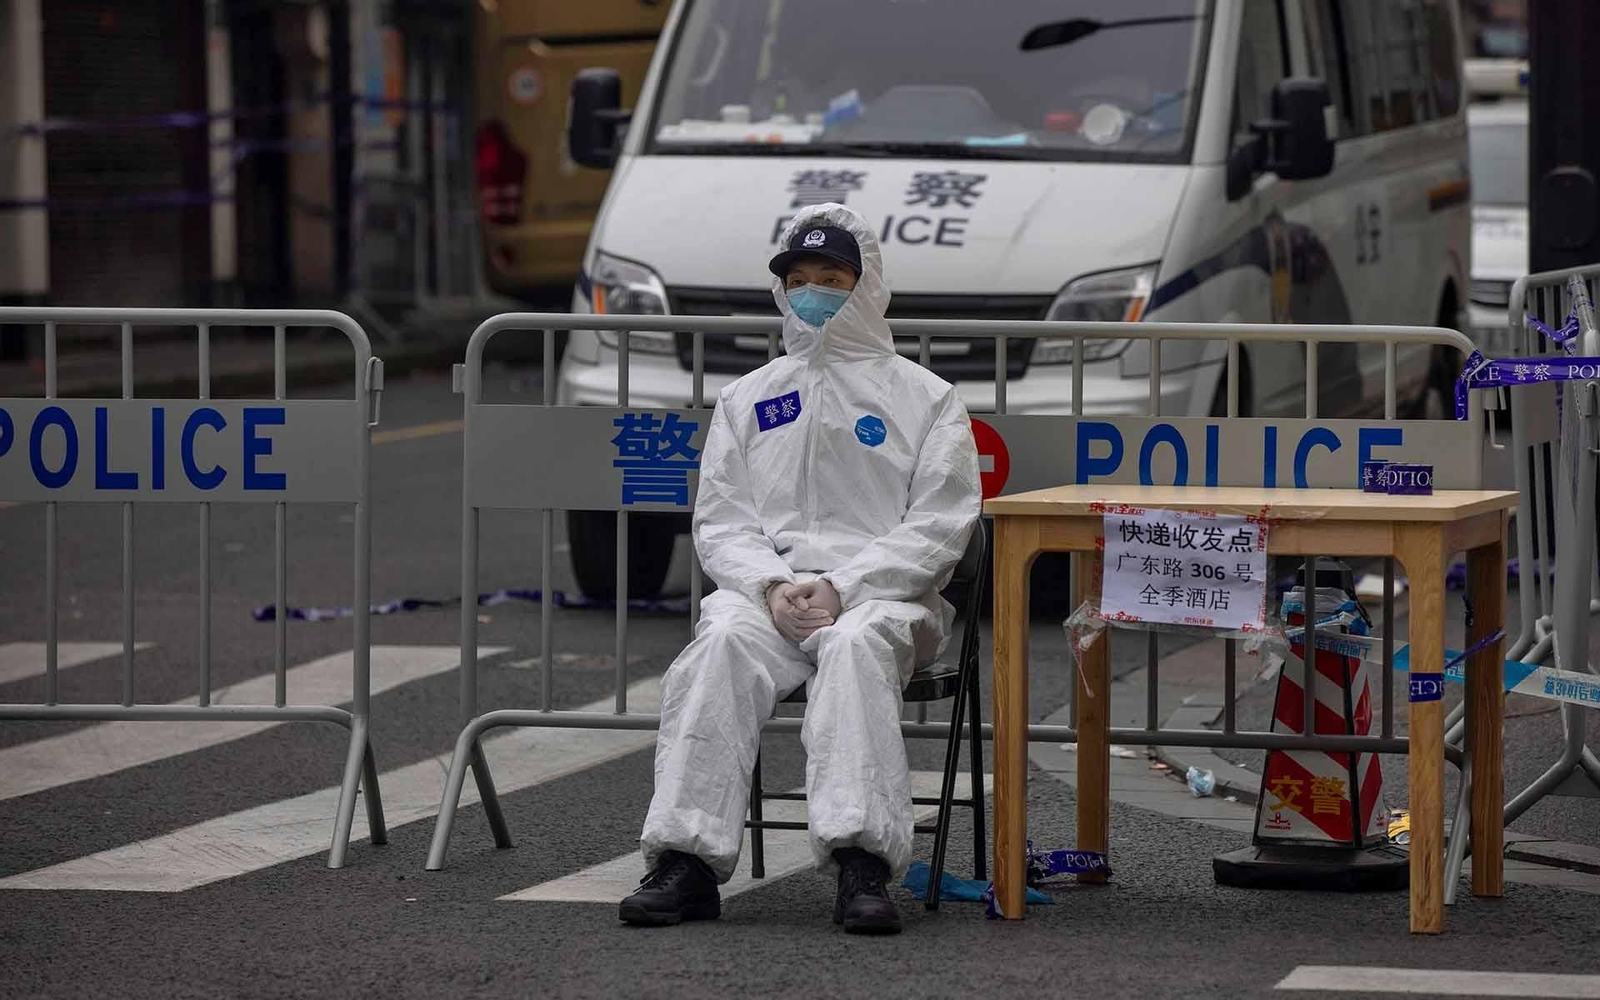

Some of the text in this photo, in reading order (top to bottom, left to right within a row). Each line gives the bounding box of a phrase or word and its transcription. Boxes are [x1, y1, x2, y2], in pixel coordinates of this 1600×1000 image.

[786, 168, 989, 208] 警察
[769, 214, 969, 248] PICE
[1512, 363, 1551, 381] 警察
[764, 398, 798, 425] 警察
[611, 412, 701, 507] 警
[1119, 519, 1254, 553] 快递收发点
[1116, 552, 1254, 583] 广东路 306 号
[1139, 583, 1232, 611] 全季酒店
[1270, 774, 1346, 816] 交警
